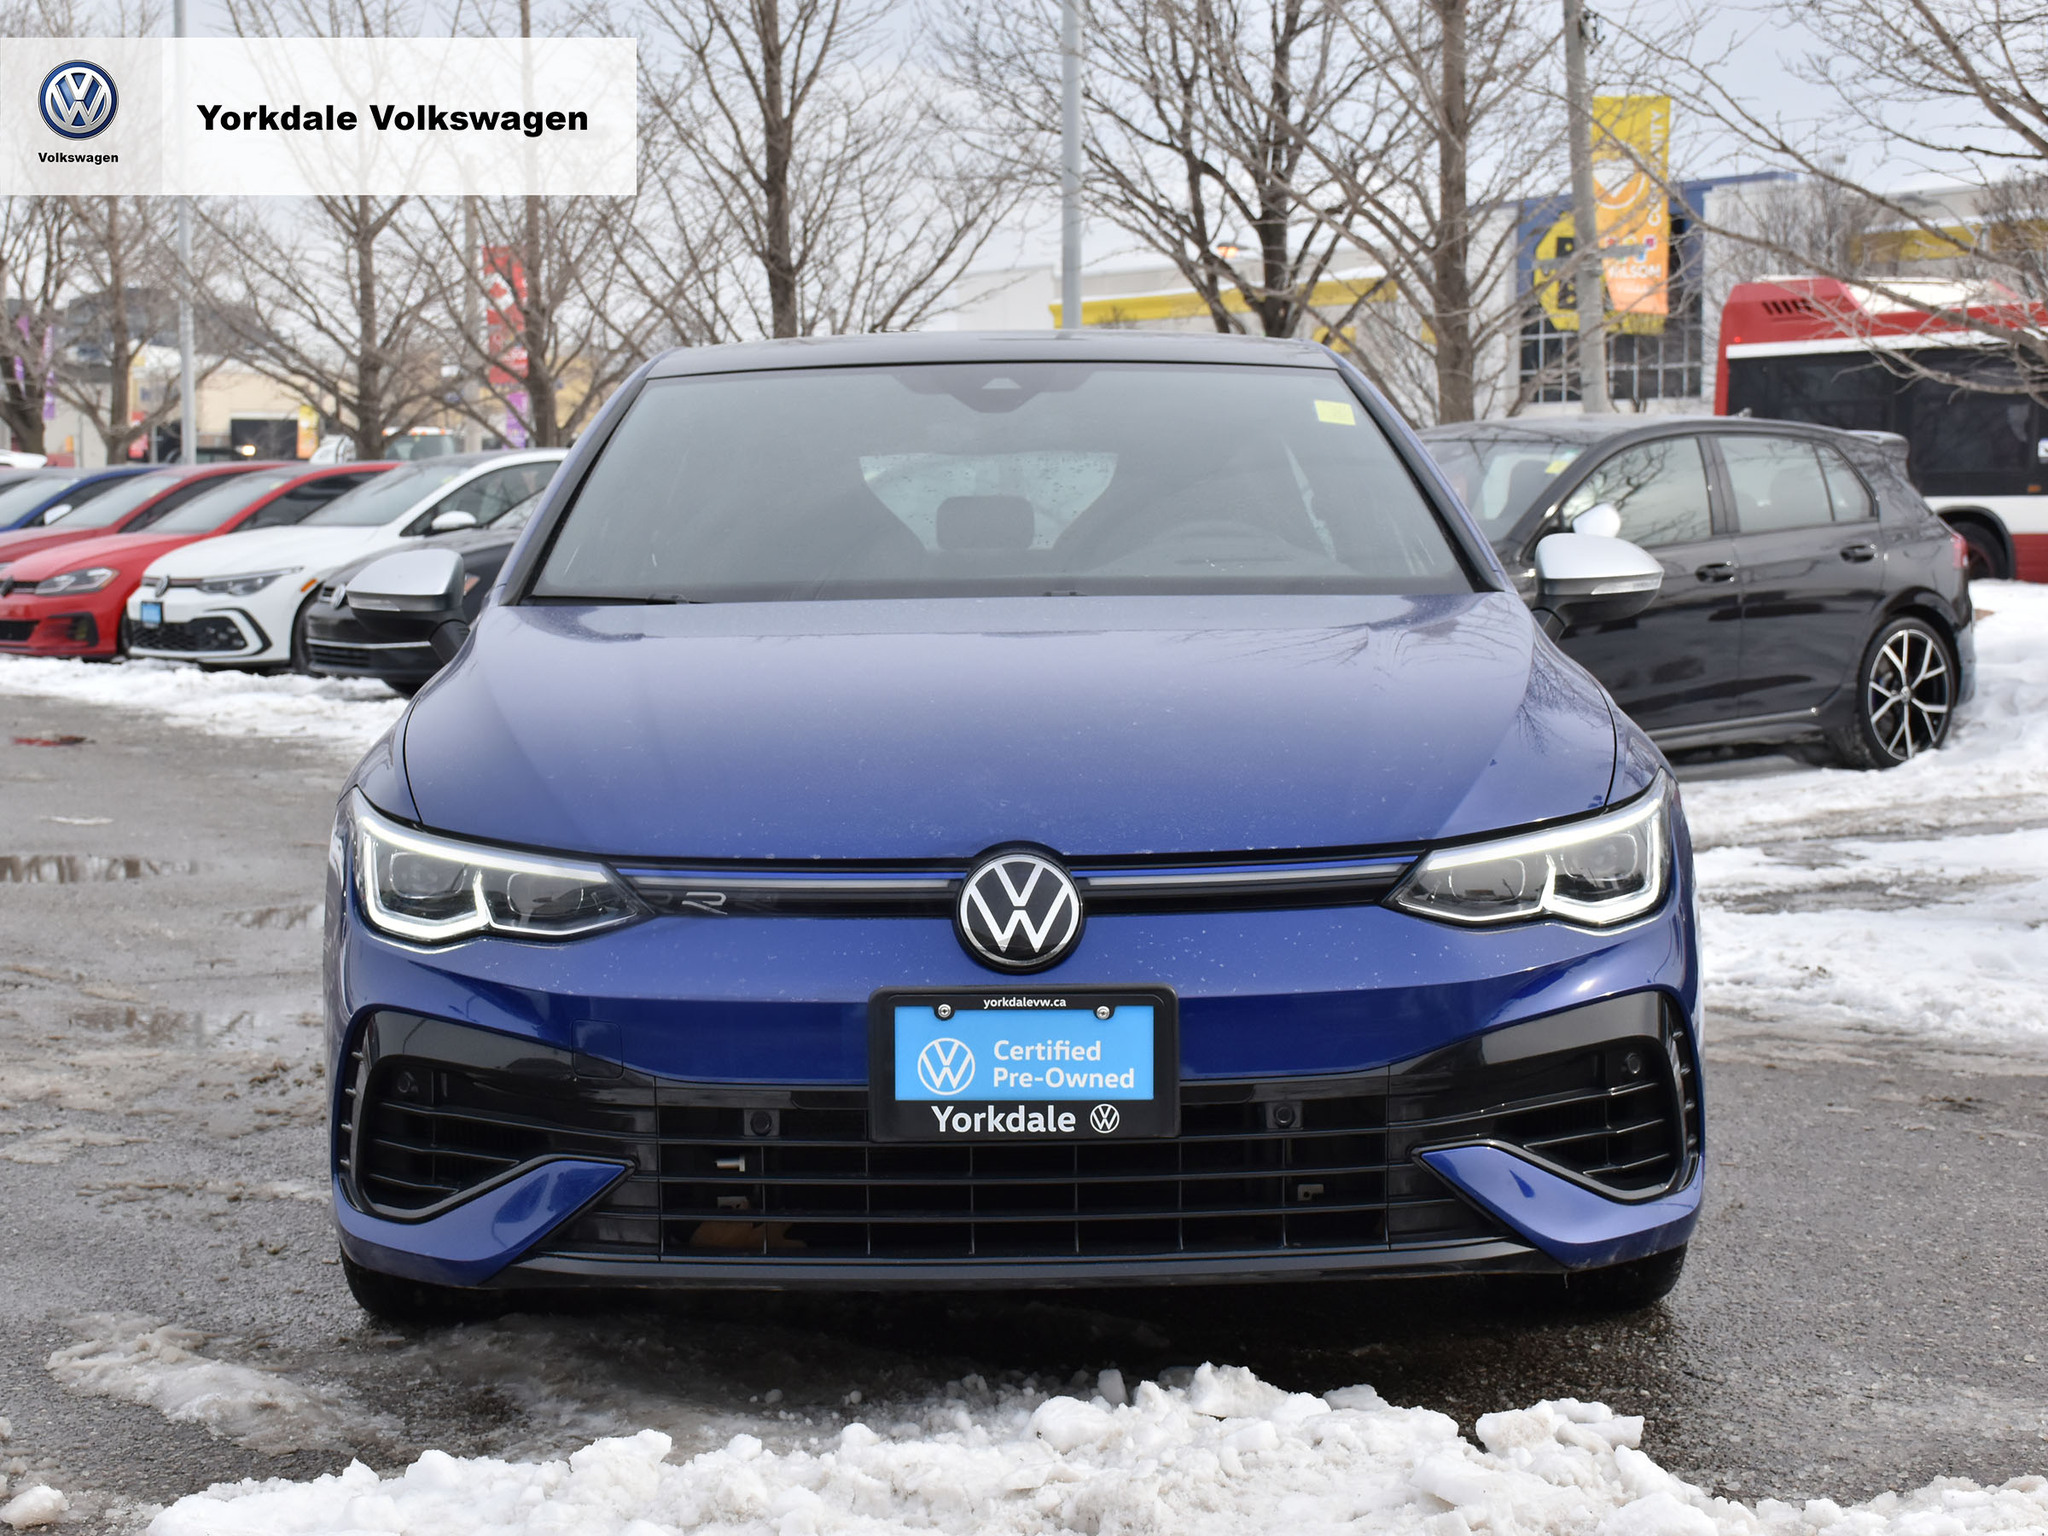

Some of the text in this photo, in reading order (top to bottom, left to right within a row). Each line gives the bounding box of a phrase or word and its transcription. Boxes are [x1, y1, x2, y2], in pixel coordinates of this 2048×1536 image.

[1646, 110, 1667, 227] CONITY
[983, 996, 1067, 1010] yorkdalevw.ca
[993, 1039, 1102, 1061] Certified
[993, 1067, 1135, 1089] Pre-Owned
[931, 1105, 1076, 1133] Yorkdale
